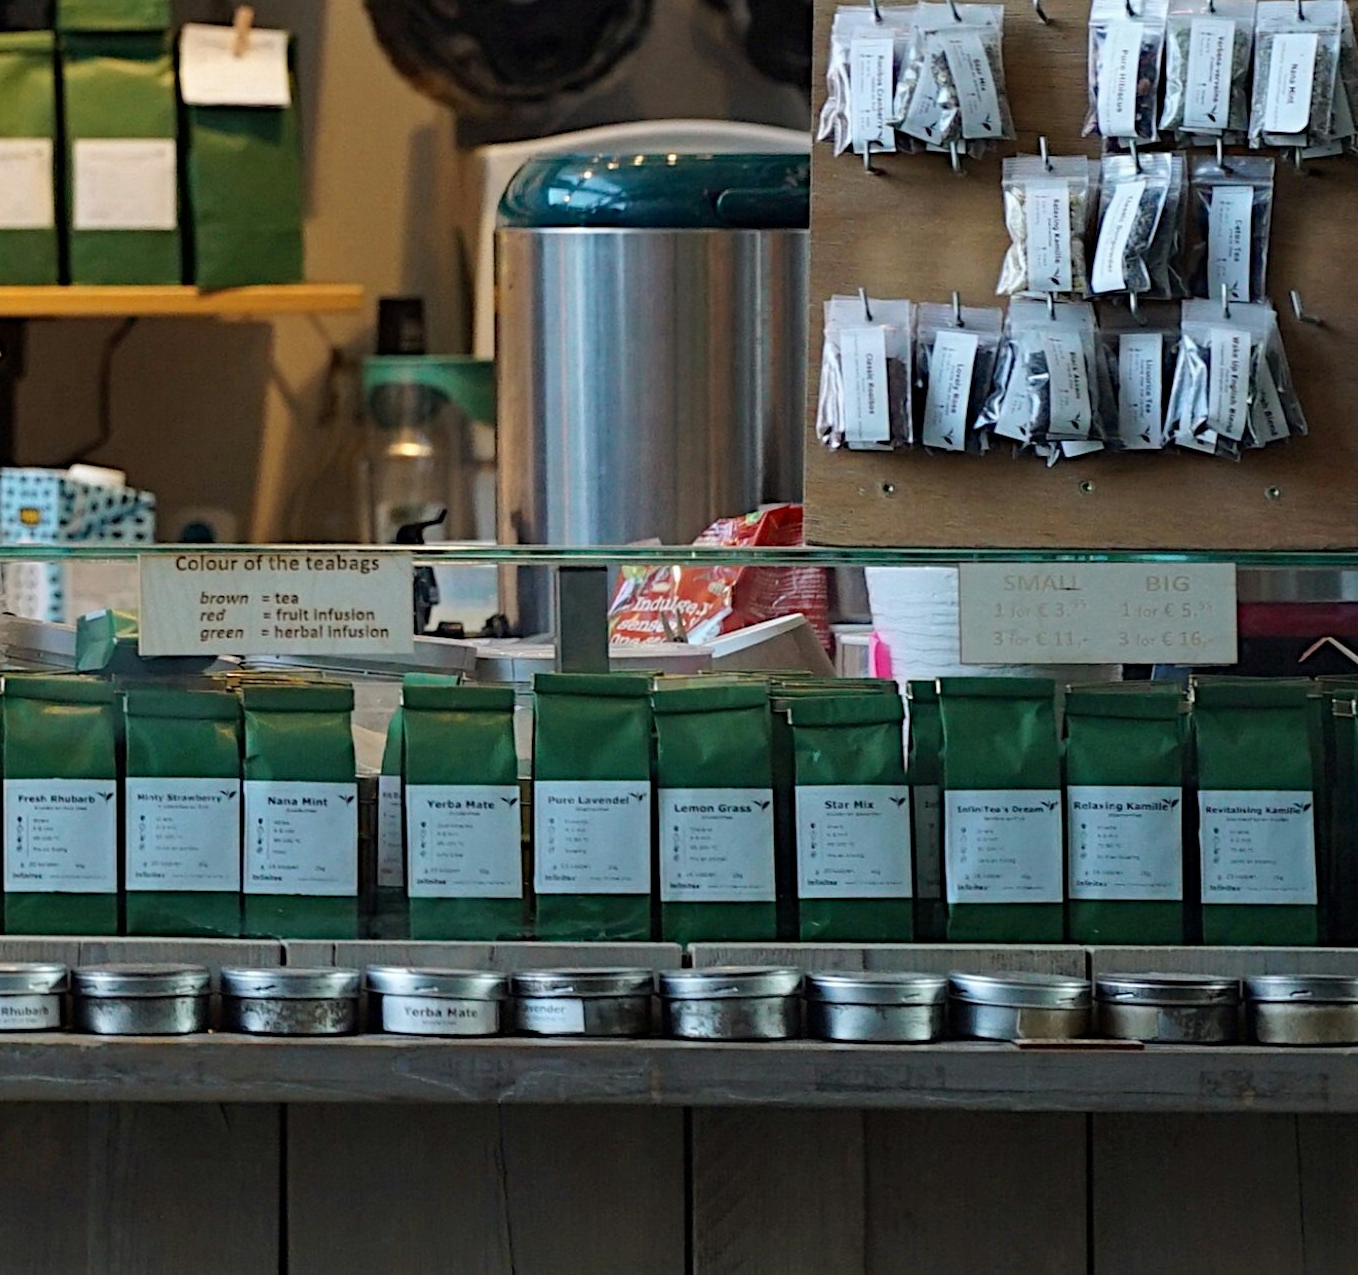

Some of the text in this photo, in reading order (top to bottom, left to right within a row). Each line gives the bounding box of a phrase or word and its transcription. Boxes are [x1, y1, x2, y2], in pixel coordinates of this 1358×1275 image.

[175, 554, 380, 575] Colour of the teabags
[1004, 576, 1190, 592] SMALL BIG
[200, 592, 299, 605] brown tea
[200, 608, 375, 622] red fruit infusion
[995, 603, 1048, 618] 1 for €
[1122, 603, 1174, 618] 1 for €
[200, 625, 389, 642] green herbal infusion
[993, 632, 1047, 647] 3 for €
[1119, 632, 1172, 647] 3 for €
[17, 794, 96, 804] Fresh Rhubarb
[137, 793, 222, 804] Minty Strawberry
[267, 796, 328, 806] Nana Mint
[579, 795, 629, 805] Lavendel
[426, 800, 495, 810] Yerba Mate
[674, 803, 752, 814] Lemon Grass
[825, 800, 874, 810] Star Mix
[1012, 805, 1044, 814] Dream
[1074, 801, 1169, 812] Relaxing Kamille
[1, 1006, 49, 1016] Rhubarb
[404, 1006, 479, 1020] Yerba Mate
